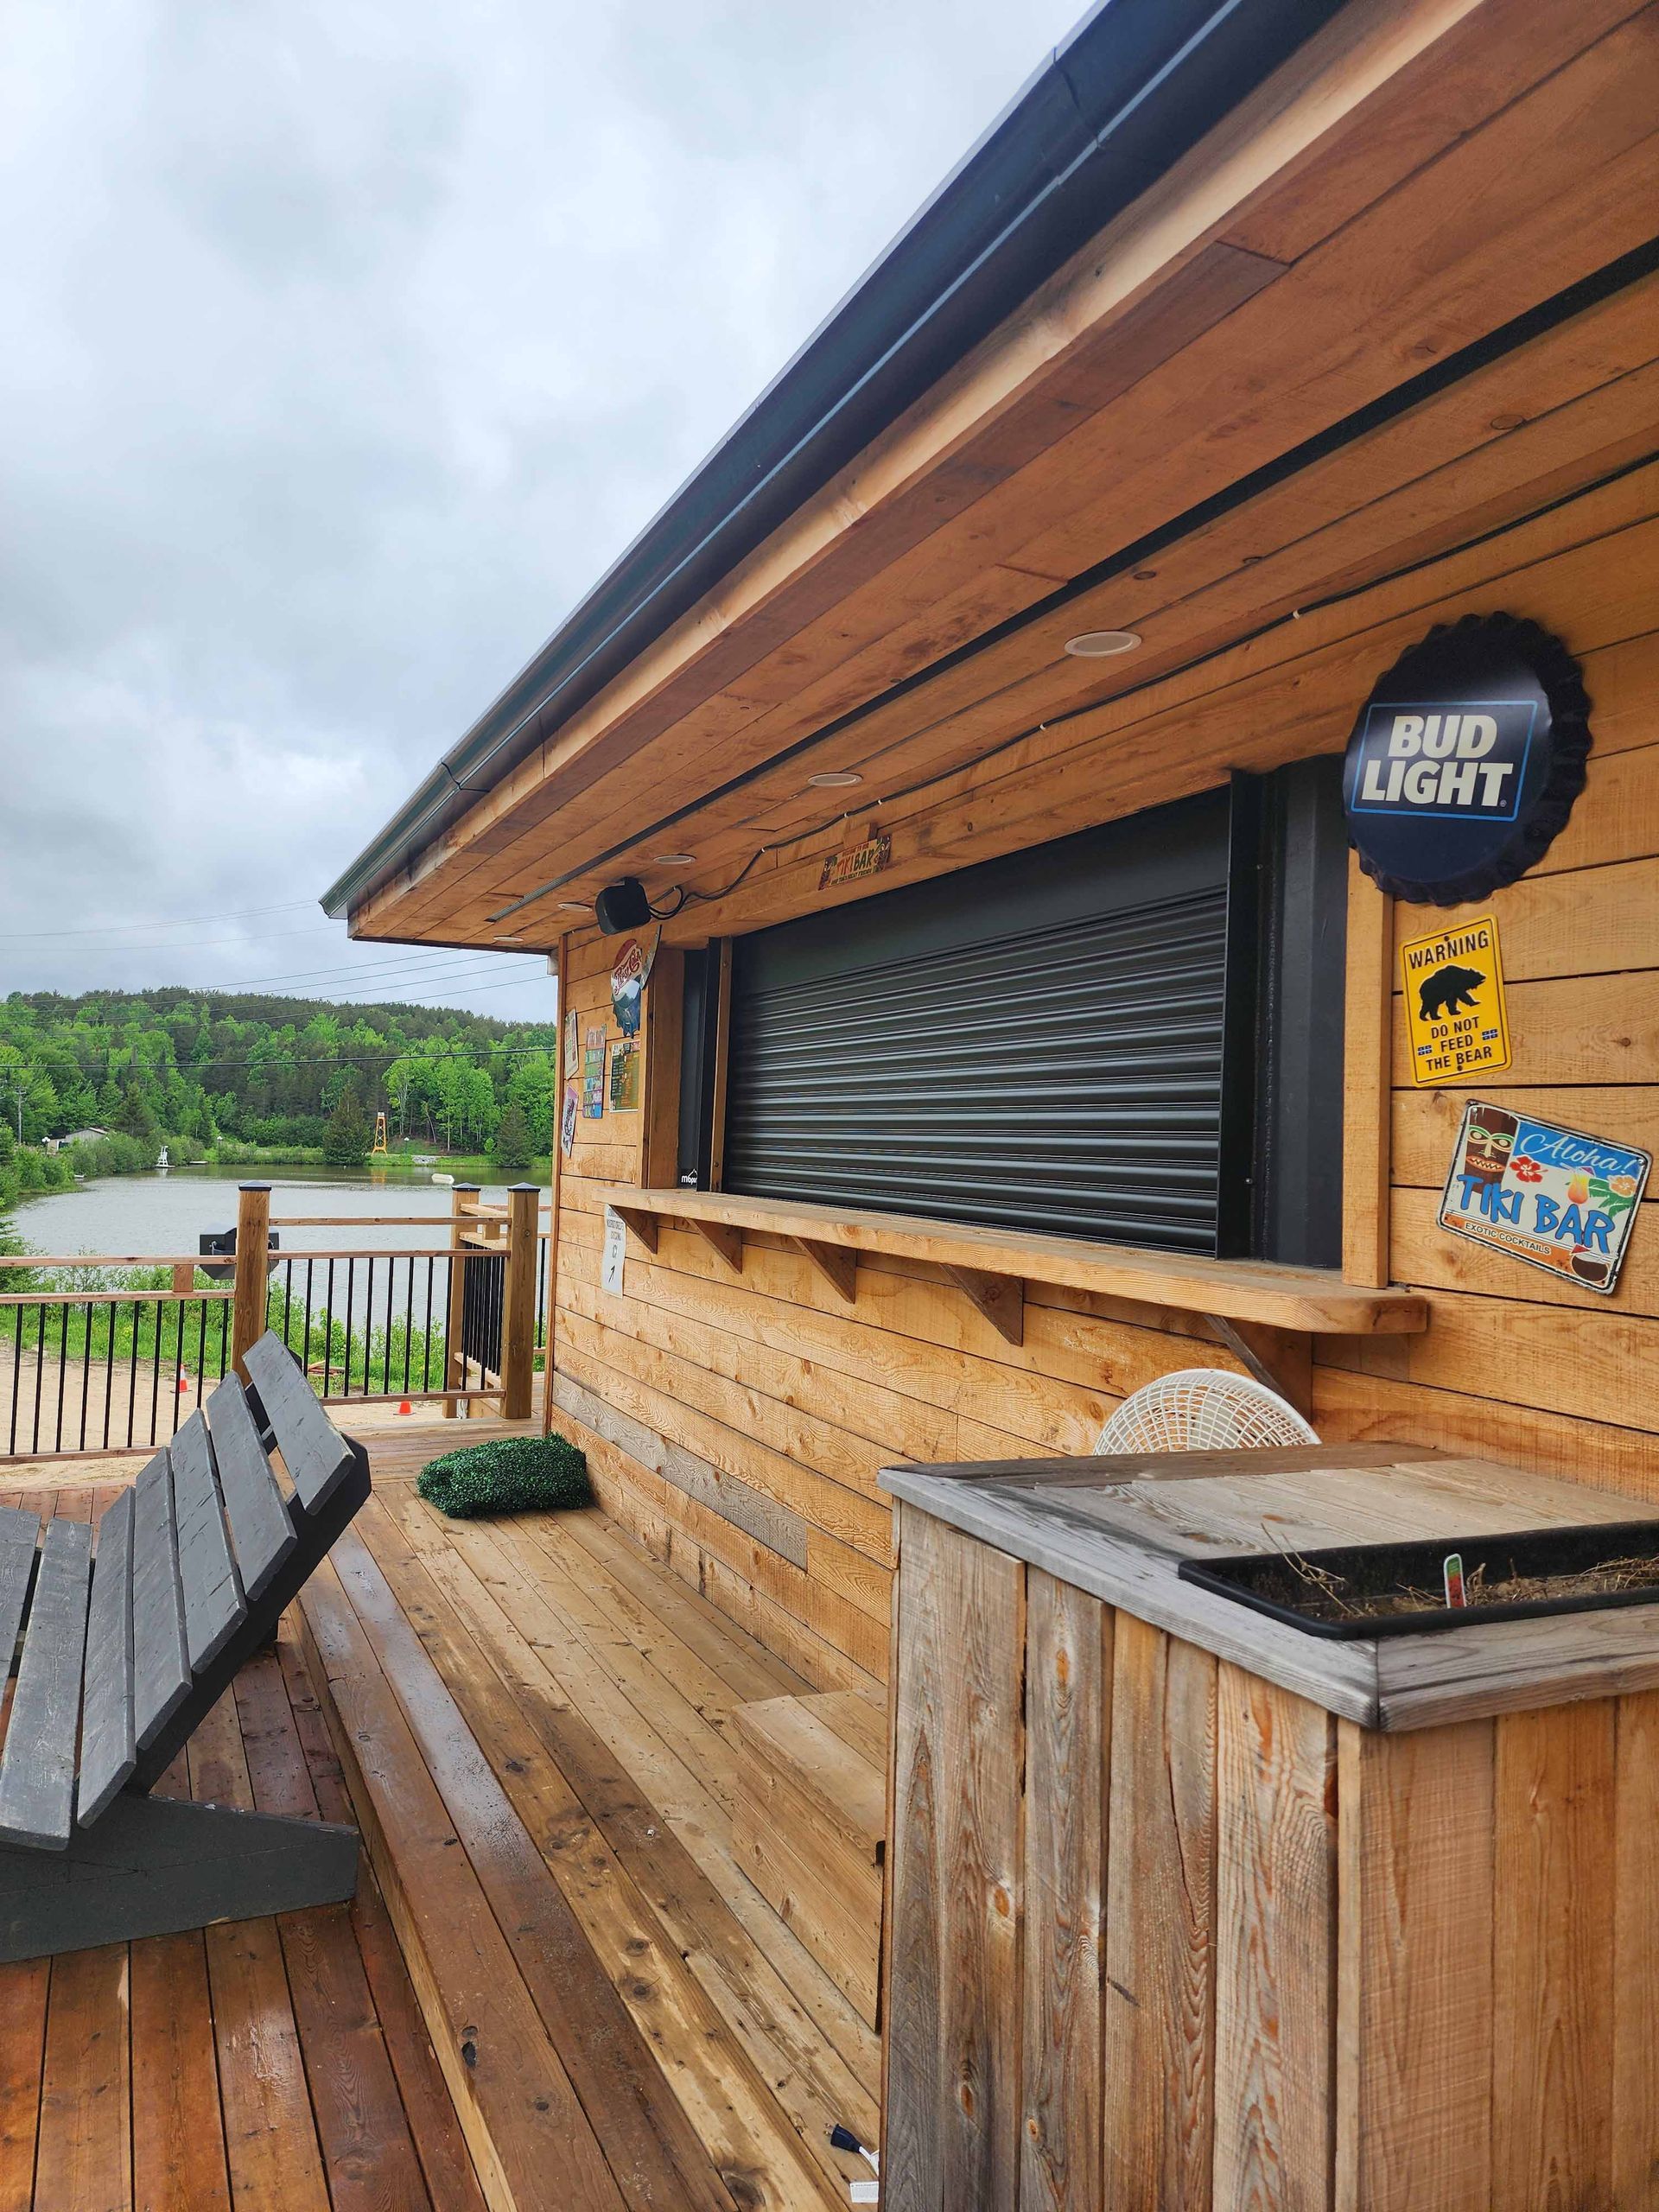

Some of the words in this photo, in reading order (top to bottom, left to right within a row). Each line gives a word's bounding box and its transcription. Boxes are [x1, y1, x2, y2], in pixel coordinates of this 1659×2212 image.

[1388, 715, 1497, 759] BUD
[1361, 760, 1514, 807] LIGHT
[1408, 930, 1490, 969] WARNING
[1431, 1024, 1448, 1039] DO
[1453, 1016, 1480, 1034] NOT
[1440, 1034, 1473, 1052] FEED
[1426, 1055, 1452, 1071] THE
[1456, 1046, 1492, 1065] BEAR
[1519, 1133, 1633, 1175] Aloha!
[1457, 1173, 1525, 1225] TIKI
[1533, 1193, 1616, 1254] BAR
[1465, 1222, 1498, 1238] EXOTIC
[1498, 1231, 1552, 1255] COCKTAILS
